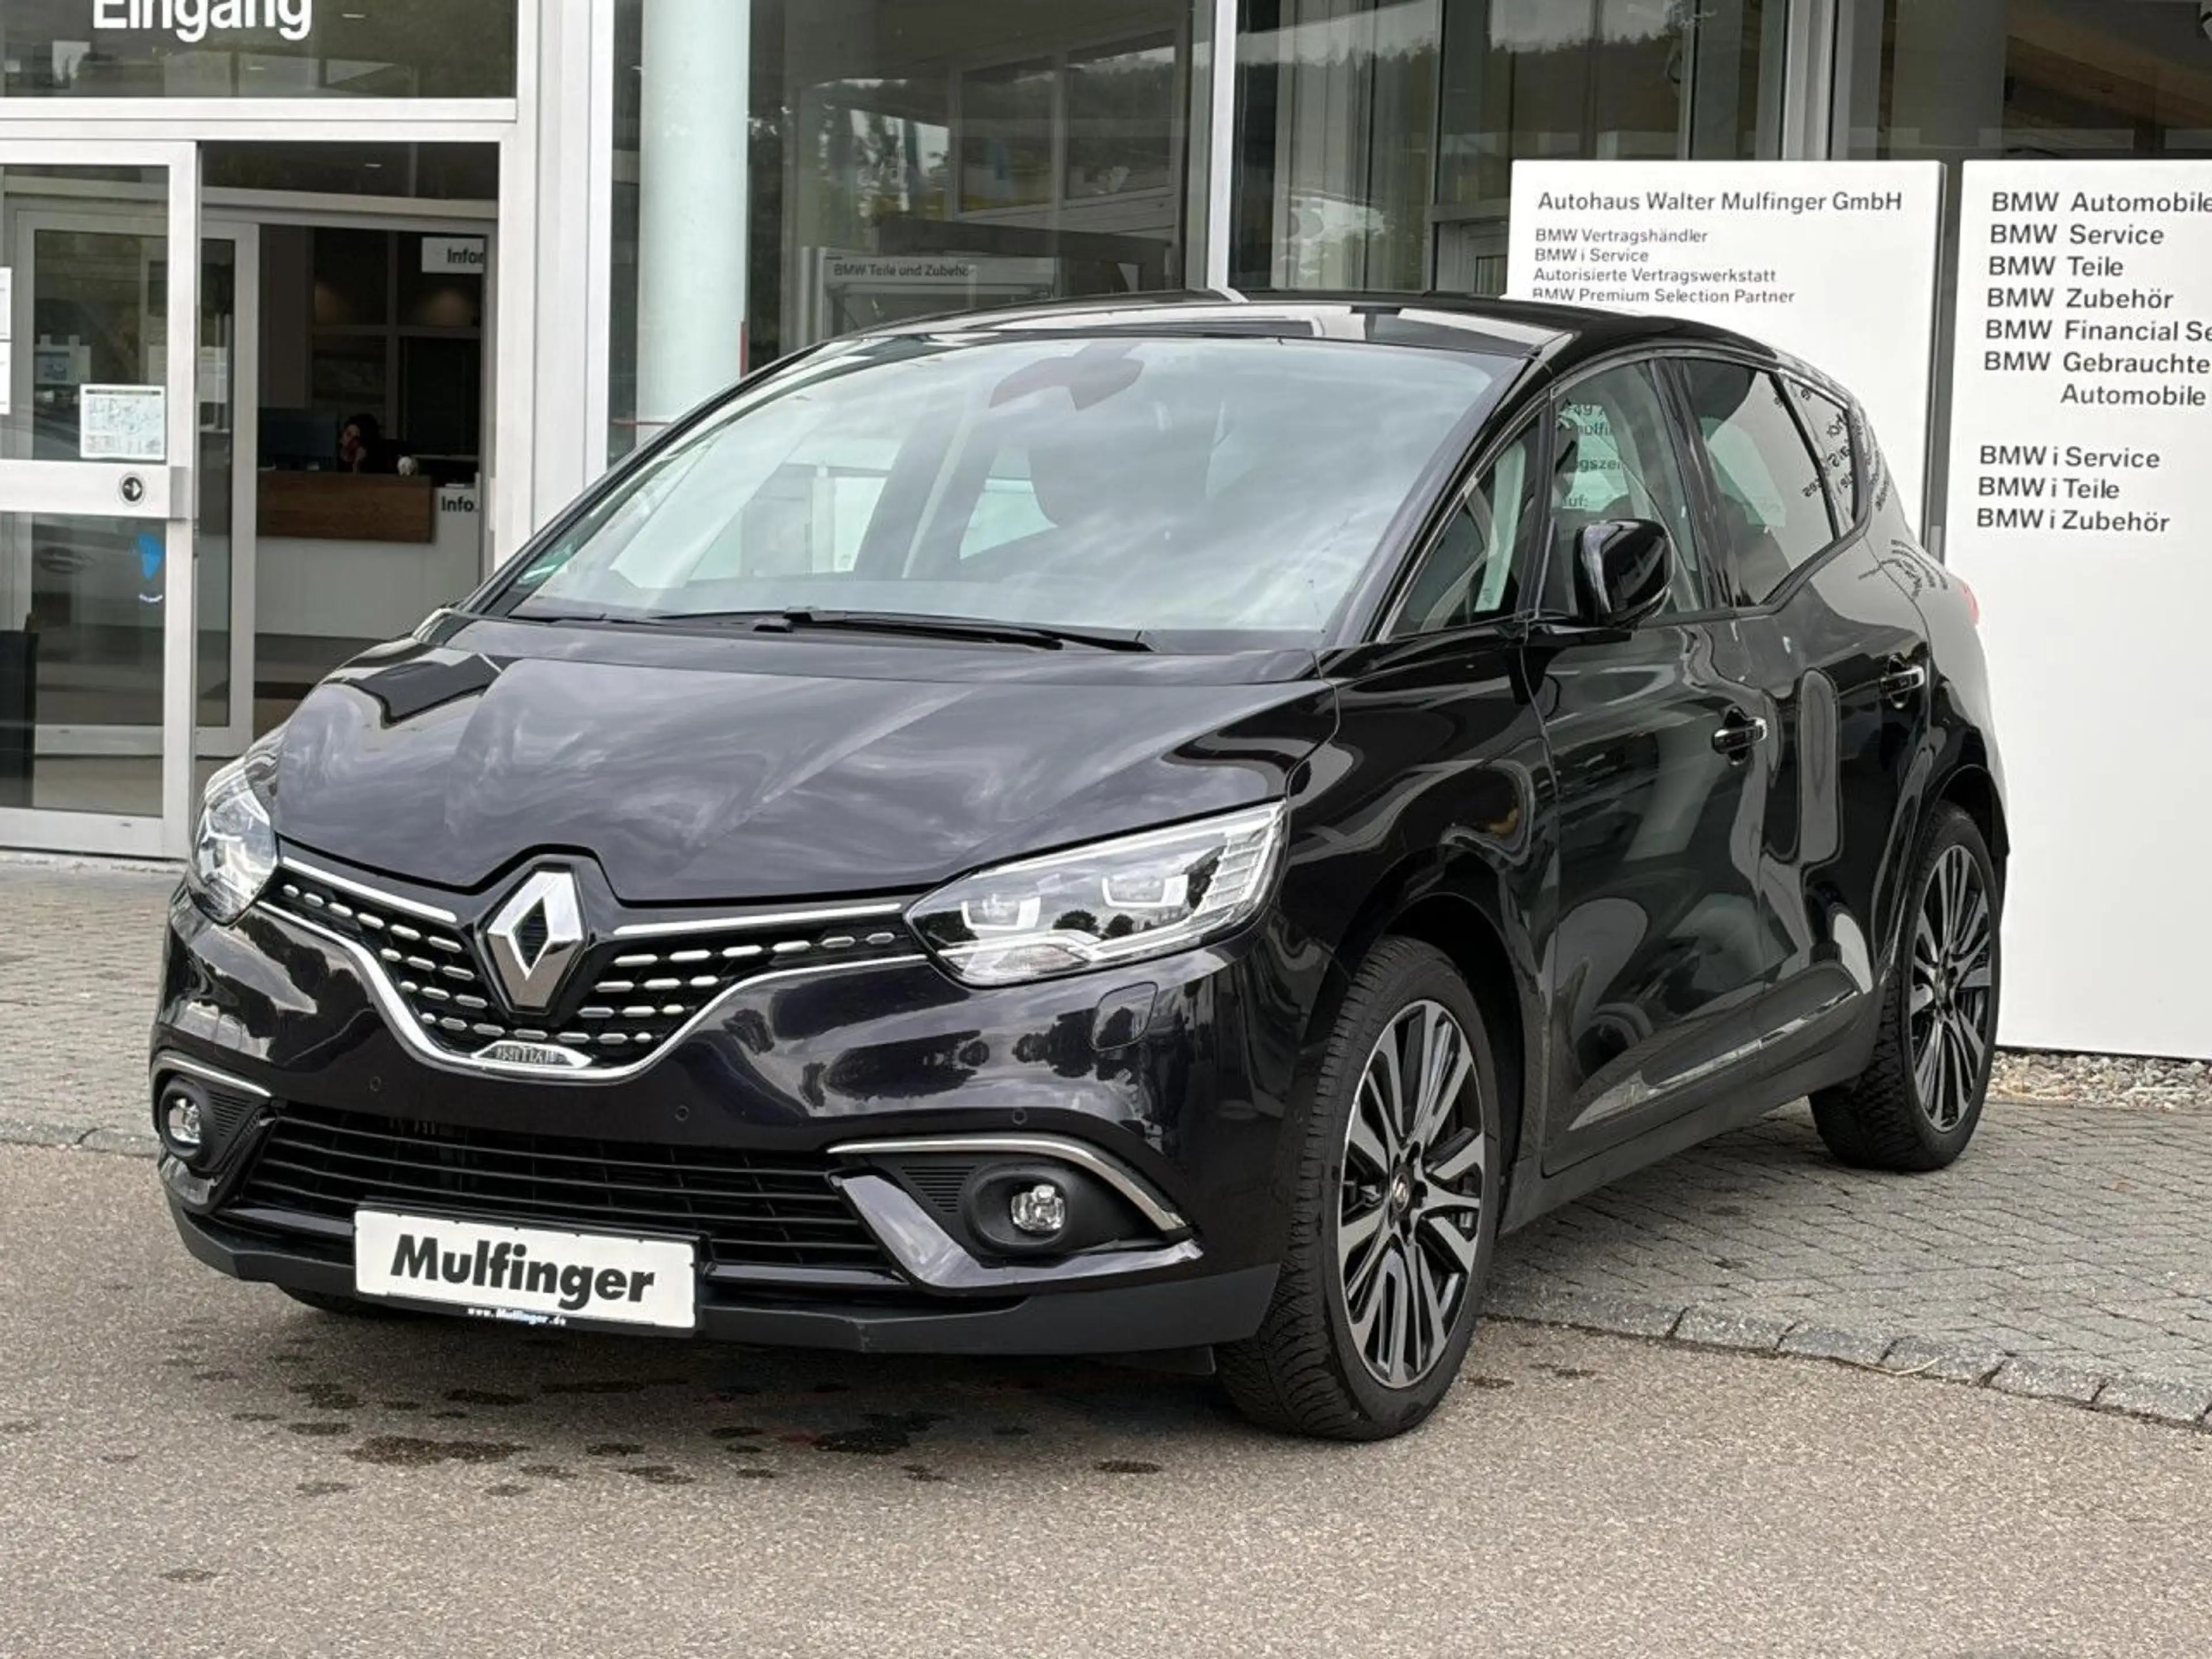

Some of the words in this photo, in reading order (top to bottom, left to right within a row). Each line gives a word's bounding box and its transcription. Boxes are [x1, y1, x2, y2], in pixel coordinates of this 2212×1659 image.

[1537, 191, 1640, 211] Autohaus
[1646, 191, 1715, 211] Walter
[1721, 191, 1827, 215] Mulfinger
[1832, 191, 1902, 211] GmbH
[1991, 191, 2060, 212] BMW
[2070, 191, 2212, 213] Automobile
[1536, 228, 1578, 243] BMW
[1581, 228, 1708, 246] Vertragshändler
[1990, 223, 2058, 245] BMW
[2069, 223, 2165, 245] Service
[1535, 248, 1577, 262] BMW
[1581, 247, 1585, 262] i
[1590, 247, 1649, 262] Service
[1533, 267, 1627, 282] Autorisierte
[1631, 267, 1776, 285] Vertragswerkstatt
[1988, 255, 2057, 276] BMW
[2066, 255, 2124, 278] Teile
[1532, 287, 1575, 301] BMW
[1579, 287, 1650, 302] Premium
[1654, 288, 1729, 303] Selection
[1734, 289, 1795, 304] Partner
[1987, 287, 2055, 308] BMW
[2066, 287, 2175, 309] Zubehör
[1985, 319, 2053, 340] BMW
[2065, 319, 2179, 342] Financial
[1984, 350, 2051, 372] BMW
[2063, 351, 2211, 374] Gebrauchte
[2060, 383, 2206, 407] Automobile
[1980, 445, 2047, 466] BMW
[2052, 445, 2059, 467] i
[2065, 445, 2161, 469] Service
[1978, 476, 2046, 498] BMW
[2051, 478, 2058, 498] i
[2062, 478, 2120, 499] Teile
[441, 495, 474, 512] Info
[1976, 507, 2045, 529] BMW
[2049, 509, 2056, 530] i
[2061, 509, 2171, 532] Zubehör
[391, 1234, 655, 1310] Mulfinger
